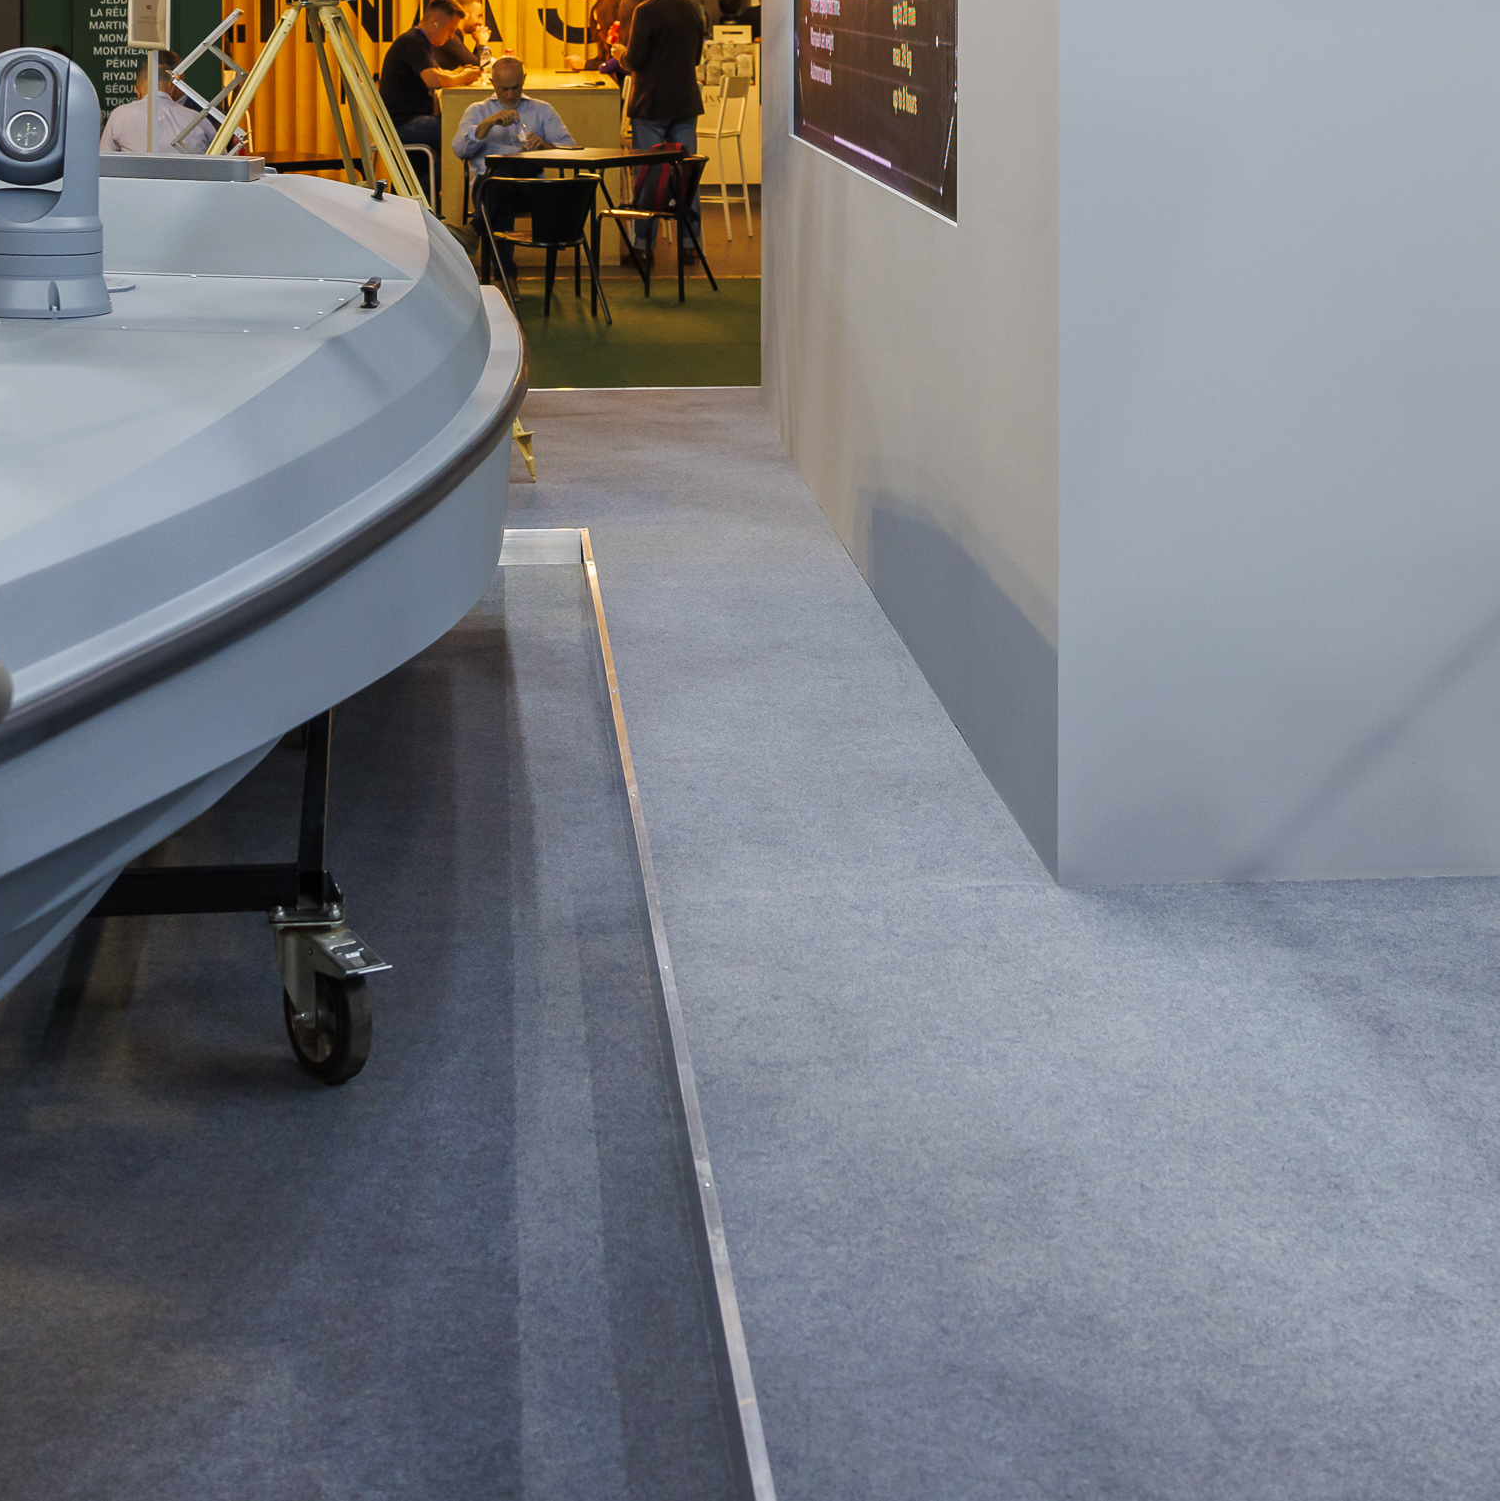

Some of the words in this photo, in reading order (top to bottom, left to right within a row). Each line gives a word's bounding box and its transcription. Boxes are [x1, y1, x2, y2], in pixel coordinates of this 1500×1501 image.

[90, 8, 103, 18] LA
[105, 5, 128, 18] RÉU
[89, 20, 128, 30] MARTIN
[105, 56, 138, 68] PÉKIN
